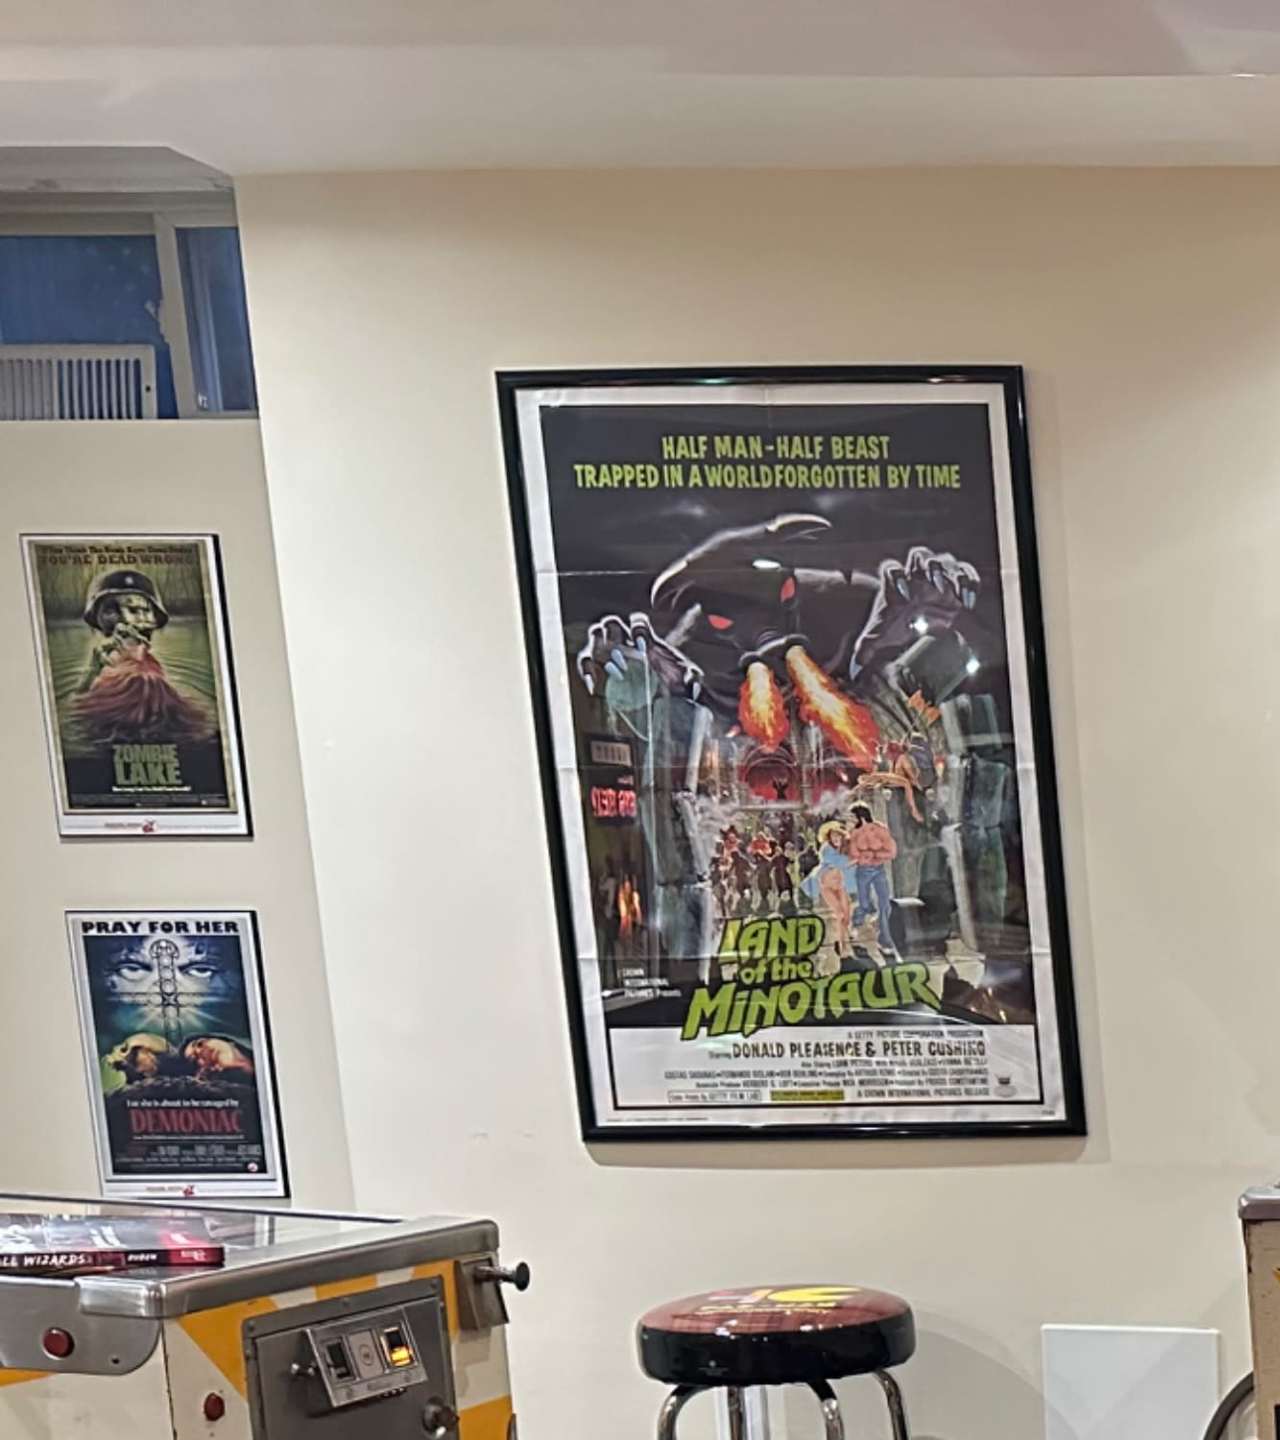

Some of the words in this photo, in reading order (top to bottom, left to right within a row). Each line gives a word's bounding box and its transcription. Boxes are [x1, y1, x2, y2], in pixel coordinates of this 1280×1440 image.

[662, 436, 707, 459] HALF
[831, 436, 890, 459] BEAST
[574, 464, 660, 489] TRAPPED
[664, 464, 684, 488] IN
[688, 464, 703, 488] A
[704, 464, 773, 489] WORLD
[774, 464, 881, 489] FORGOTTEN
[887, 464, 911, 489] BY
[914, 464, 961, 489] TIME
[112, 744, 178, 763] ZOMBIE
[115, 761, 183, 785] LAKE
[81, 921, 141, 934] PRAY
[148, 921, 190, 934] FOR
[195, 921, 240, 933] HER
[720, 916, 826, 955] LAND
[740, 959, 769, 985] of
[770, 956, 814, 982] the
[732, 1041, 784, 1058] DONALD
[865, 1041, 877, 1056] &
[883, 1040, 923, 1056] PETER
[130, 1108, 244, 1133] DEMONIAC
[24, 1253, 86, 1267] WIZARDS
